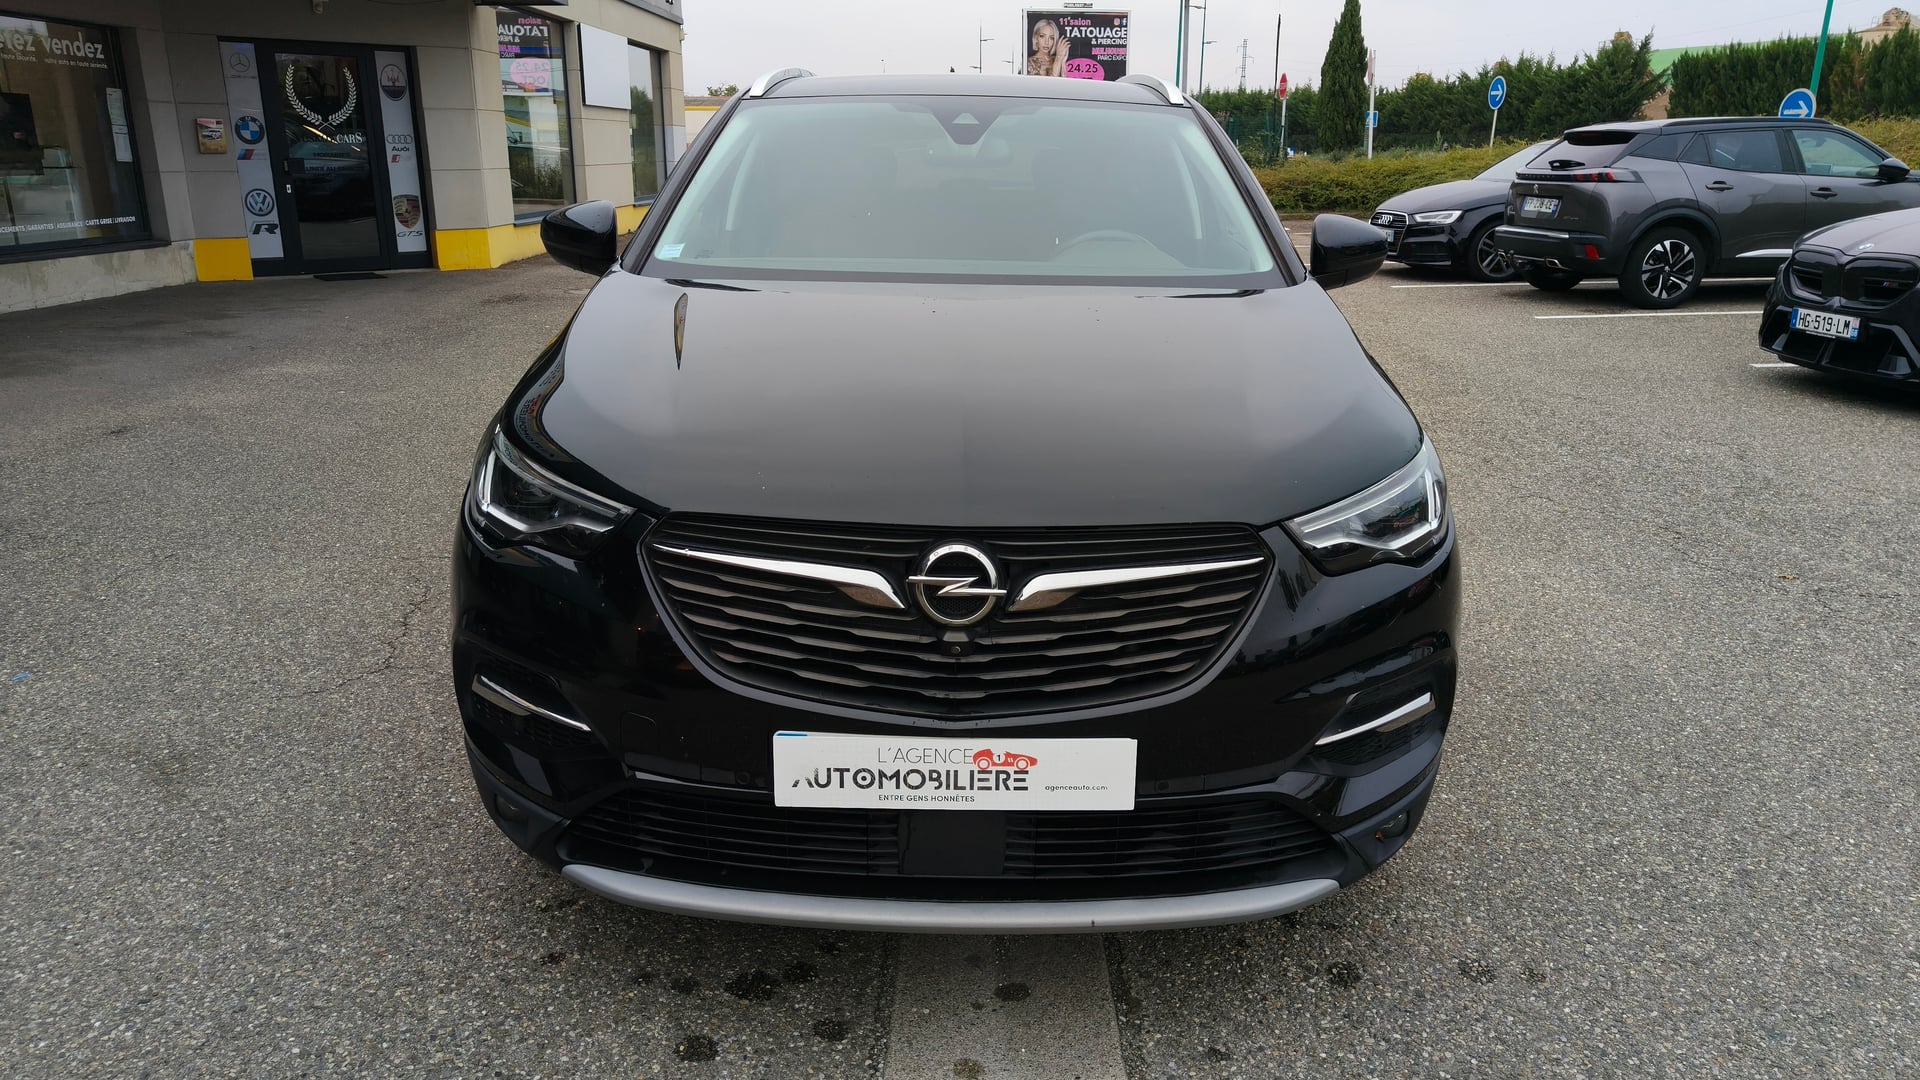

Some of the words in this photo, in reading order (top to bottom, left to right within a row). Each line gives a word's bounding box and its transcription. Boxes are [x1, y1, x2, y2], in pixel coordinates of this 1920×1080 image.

[1065, 26, 1128, 38] TATOUAGE
[1067, 63, 1098, 73] 24.25
[0, 225, 26, 233] CEMENTS
[397, 230, 423, 238] GTS
[1798, 311, 1851, 336] HG-519-LM
[878, 794, 904, 802] ENTRE
